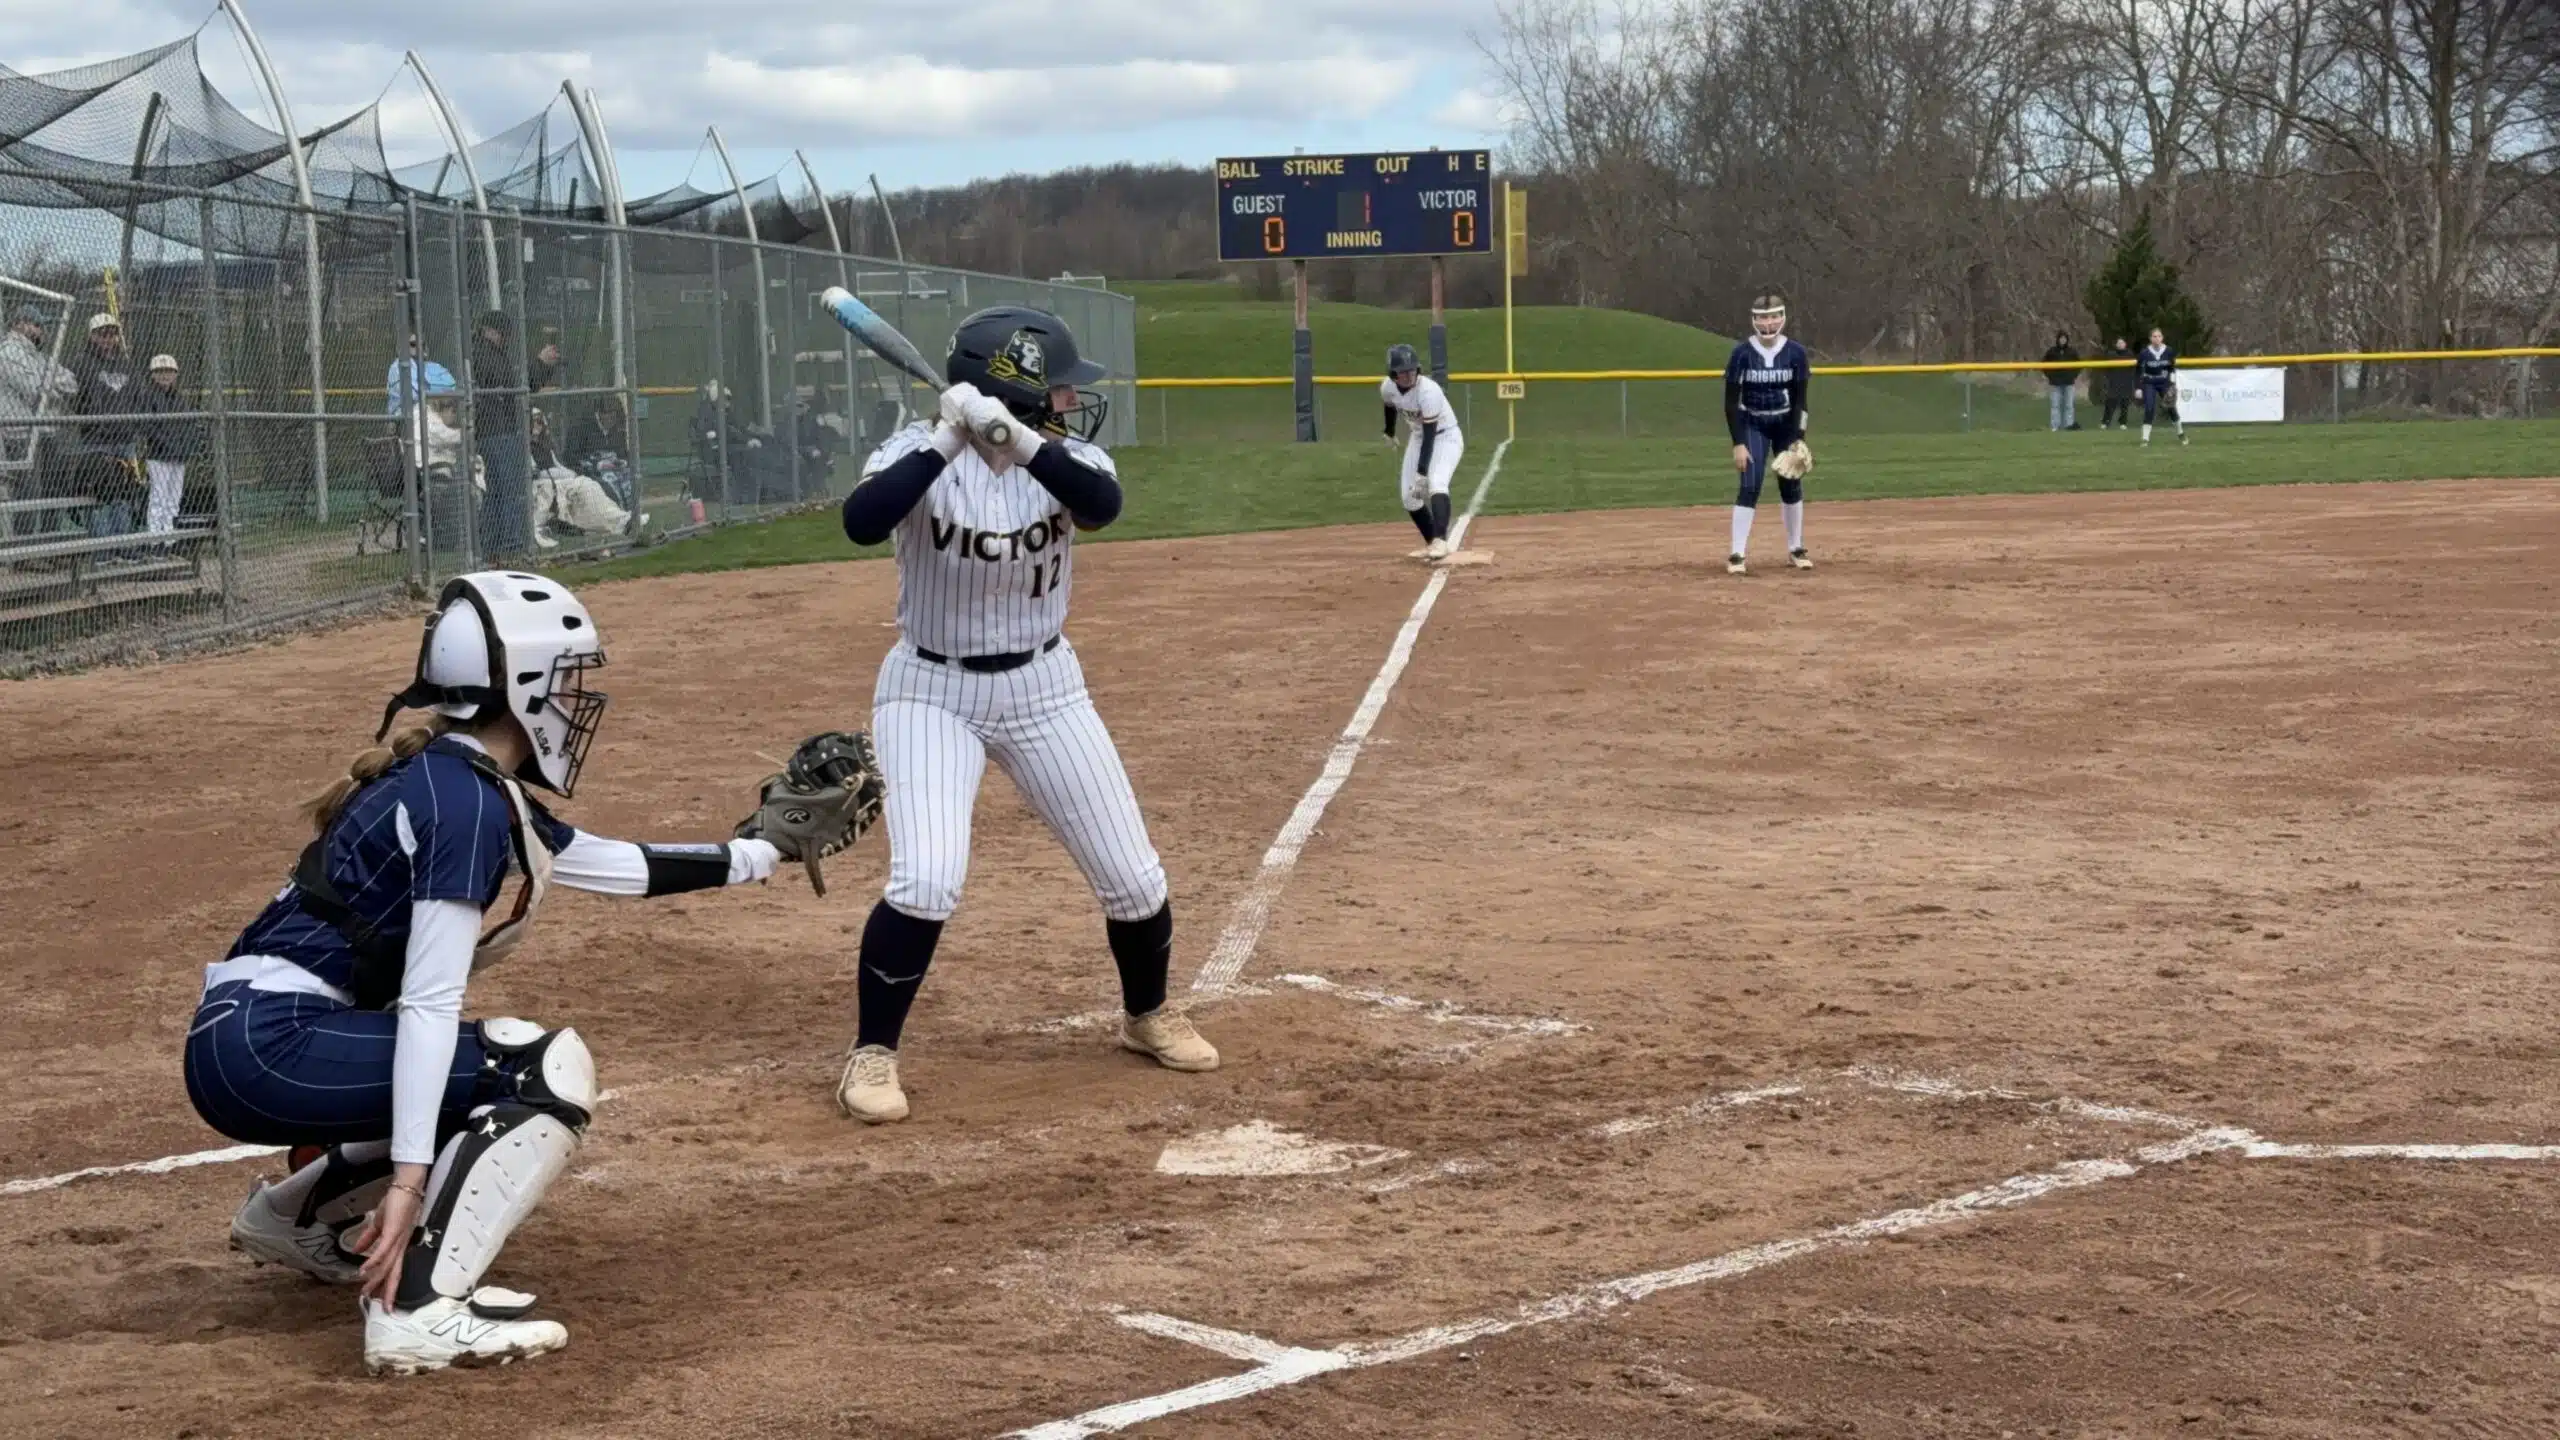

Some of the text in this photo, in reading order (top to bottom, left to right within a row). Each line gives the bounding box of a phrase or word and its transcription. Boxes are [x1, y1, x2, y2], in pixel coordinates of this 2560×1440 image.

[1219, 154, 1485, 179] BALL STRIKE OUT H E
[1232, 195, 1285, 214] GUEST
[1418, 189, 1478, 209] VICTOR
[1264, 216, 1285, 252] 0
[1326, 231, 1382, 248] INNING
[1453, 211, 1474, 246] 0
[931, 514, 1068, 562] VICTOR
[1029, 553, 1062, 598] 12
[428, 1312, 499, 1345] N
